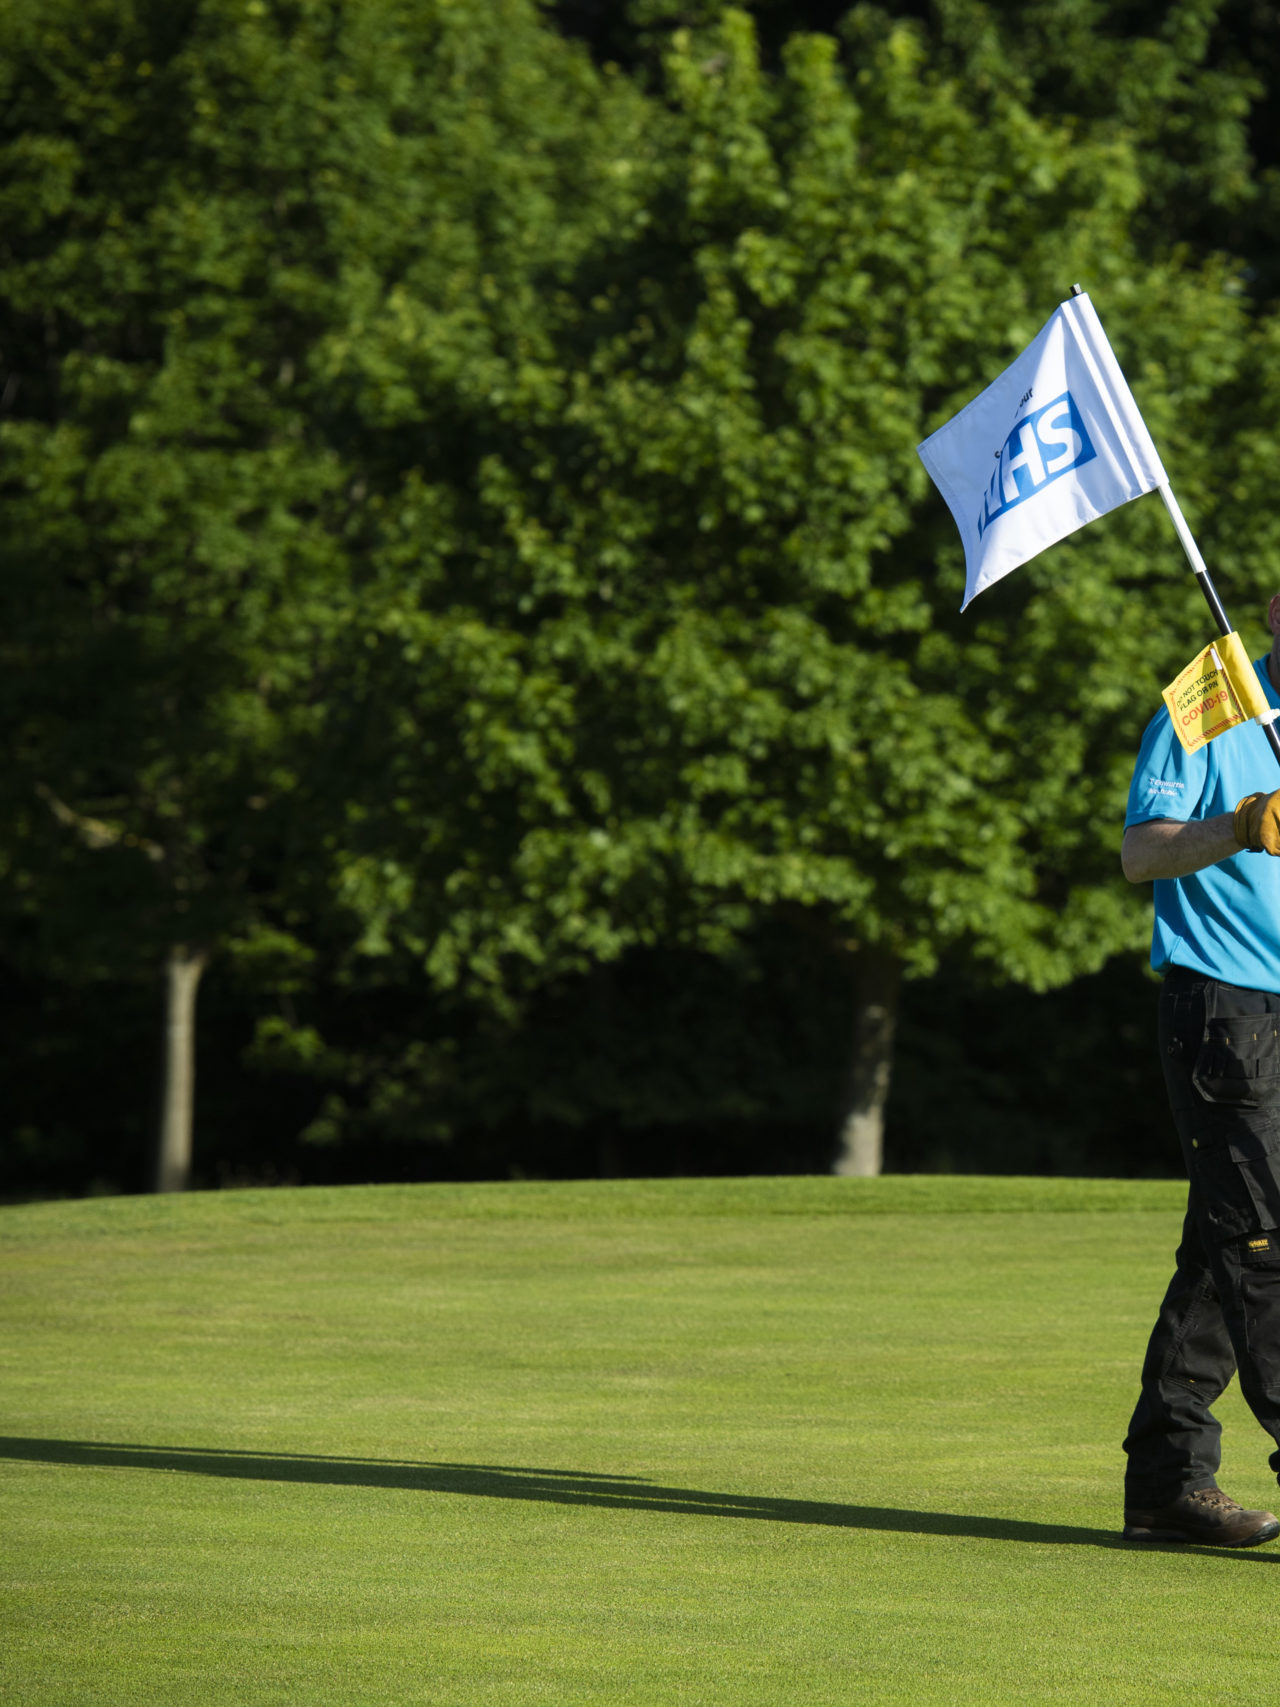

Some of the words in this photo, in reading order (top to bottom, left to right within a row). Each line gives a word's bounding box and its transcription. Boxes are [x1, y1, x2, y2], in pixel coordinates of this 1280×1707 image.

[1180, 694, 1196, 711] FLAG
[1196, 686, 1208, 697] OR
[1208, 679, 1218, 690] PIN
[1182, 683, 1196, 697] NOT
[1195, 668, 1218, 686] TOUCH
[1182, 690, 1228, 726] COVID-19
